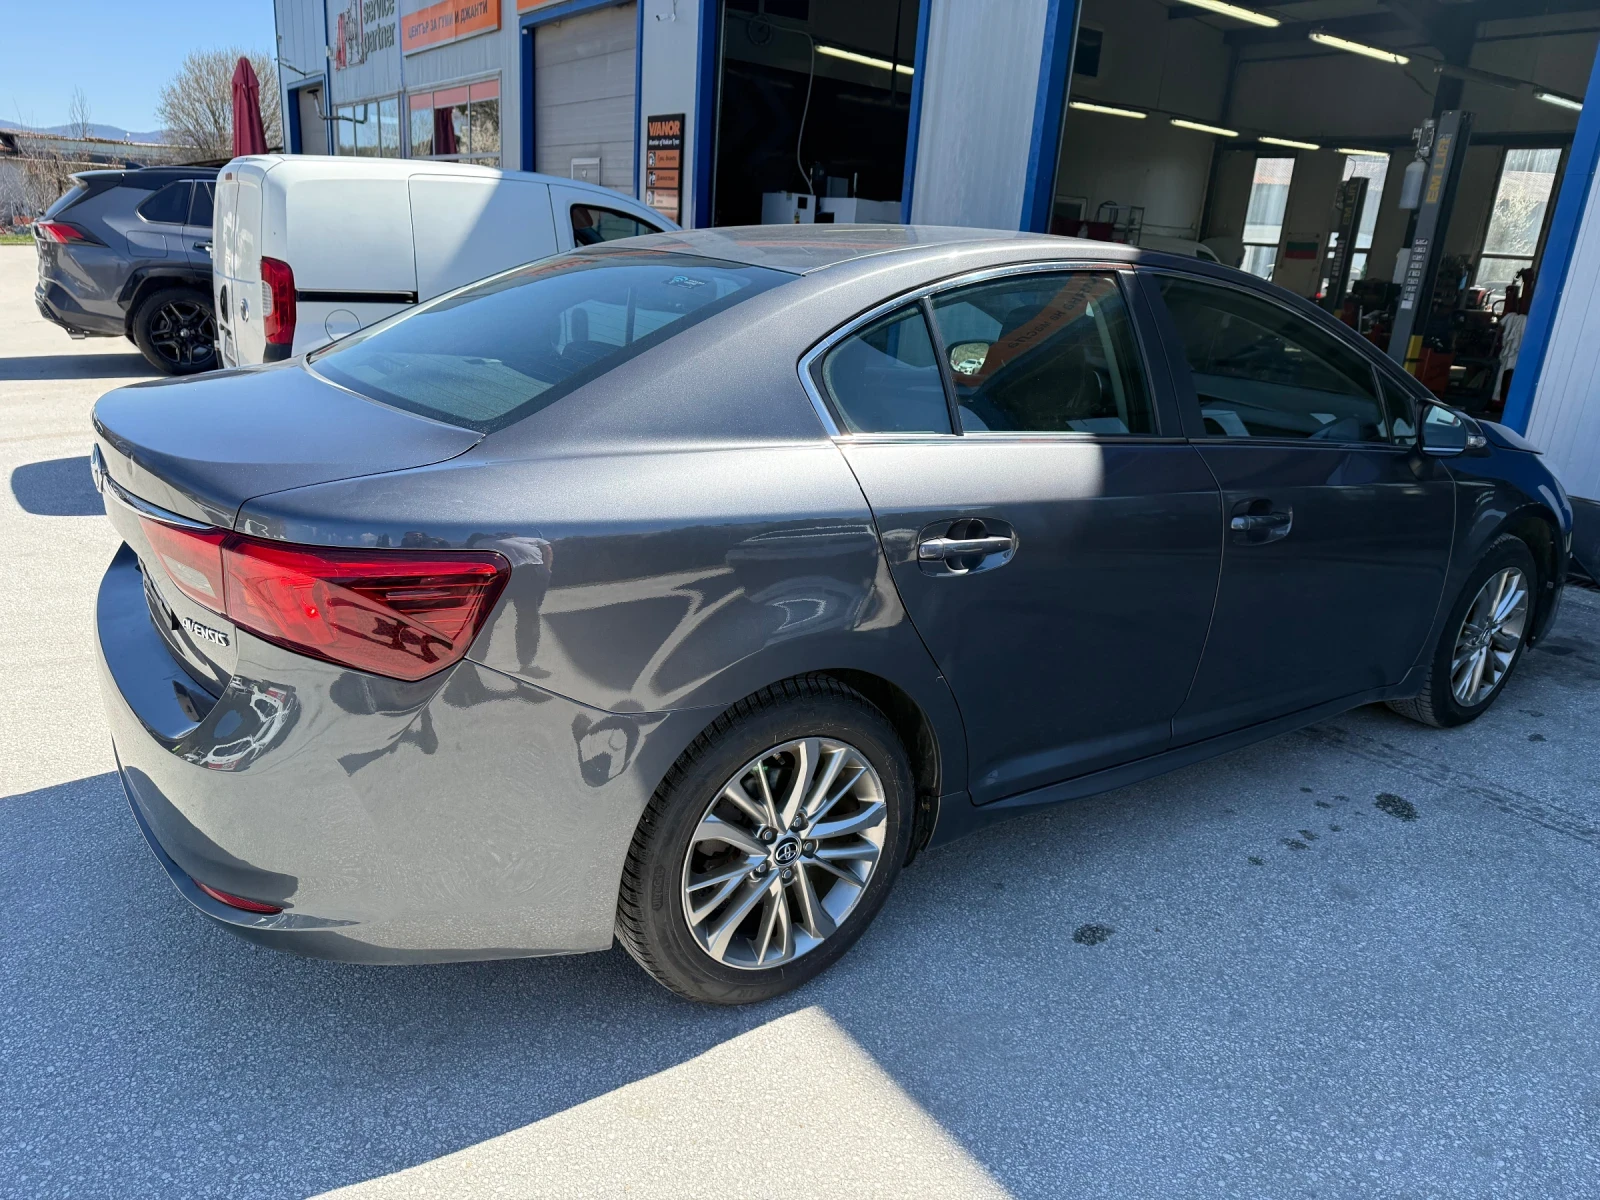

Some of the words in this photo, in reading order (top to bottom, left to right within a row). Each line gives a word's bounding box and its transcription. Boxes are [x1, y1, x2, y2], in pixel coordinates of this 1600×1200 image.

[364, 0, 394, 24] service
[408, 21, 429, 40] ЦЕНТЪР
[430, 19, 438, 31] ЗА
[455, 10, 460, 24] И
[460, 0, 488, 24] ДЖАНТИ
[364, 22, 395, 61] partner
[649, 120, 680, 136] VIANOR
[1426, 176, 1442, 203] EM
[182, 617, 230, 647] AVENSIS
